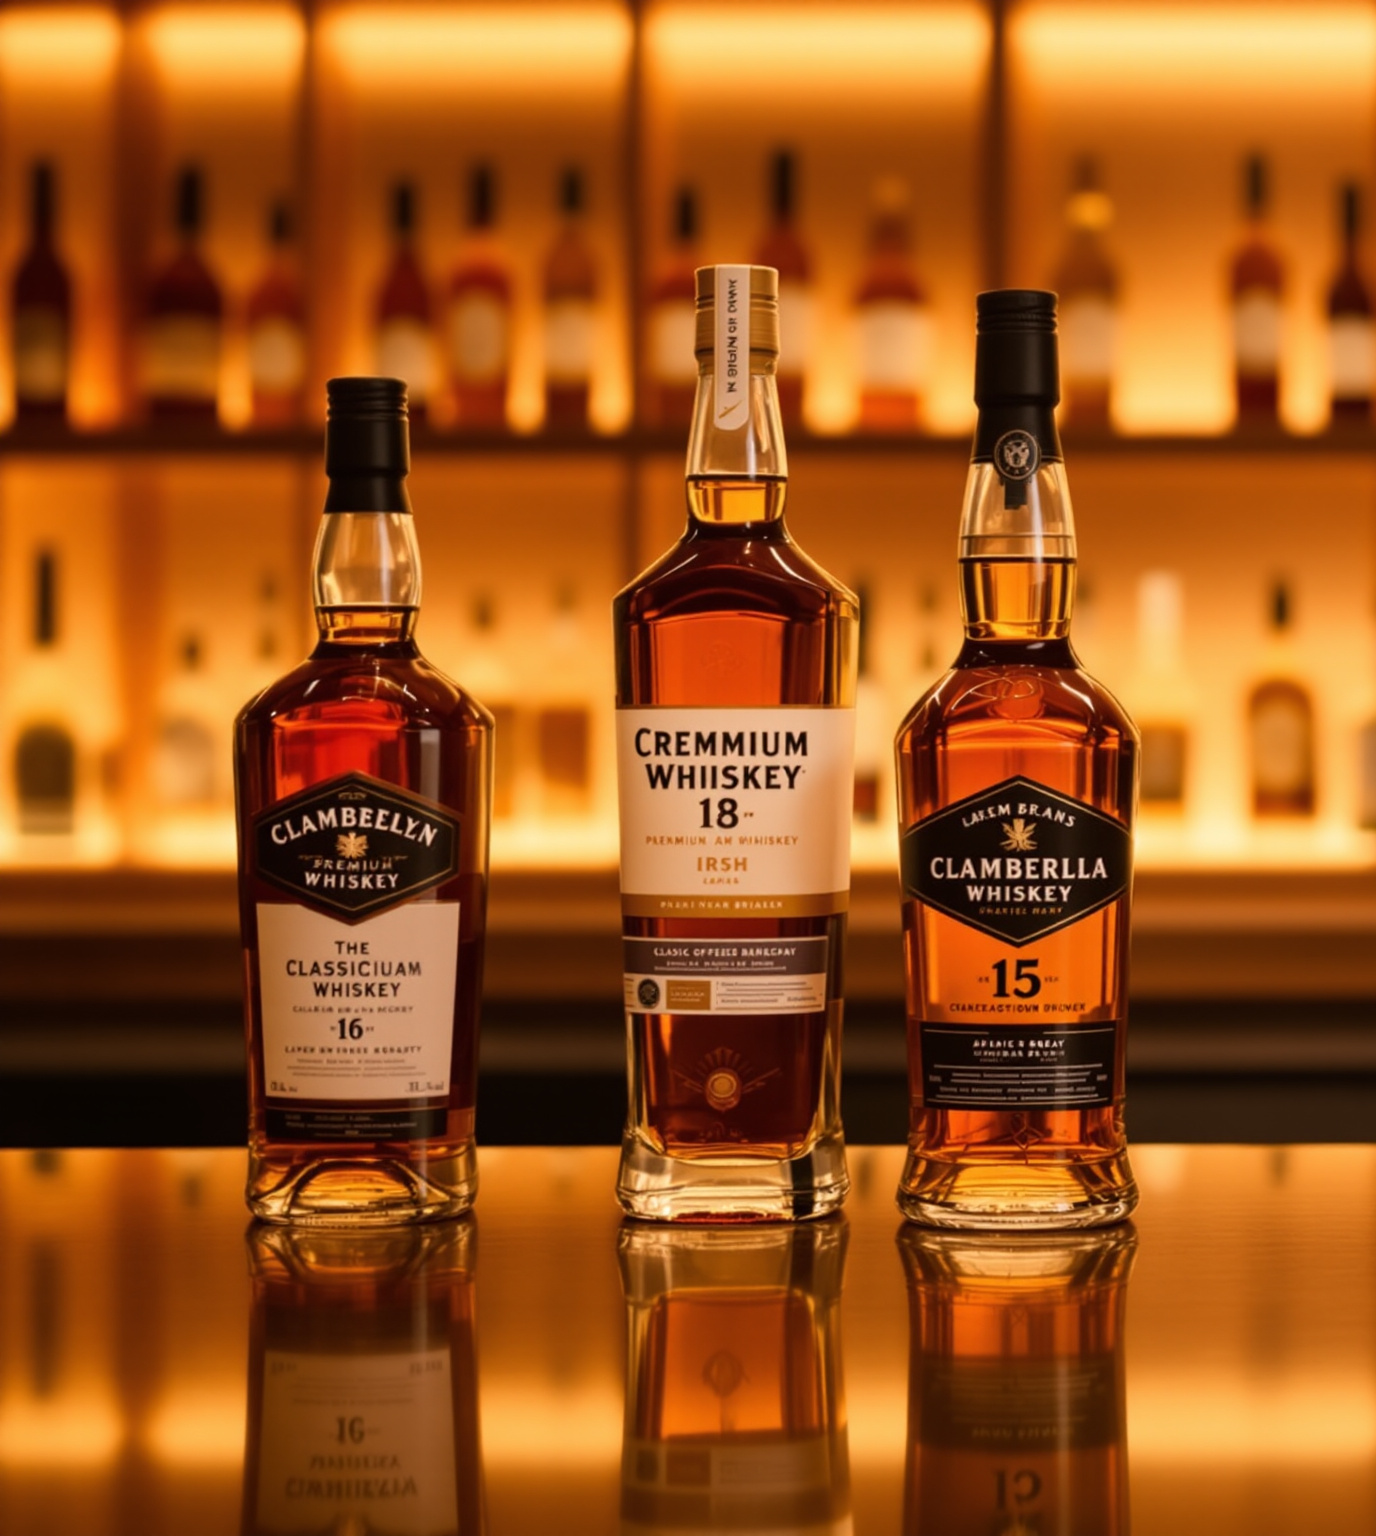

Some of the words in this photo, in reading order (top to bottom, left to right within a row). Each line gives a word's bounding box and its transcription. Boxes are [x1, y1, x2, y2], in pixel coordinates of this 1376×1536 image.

[635, 727, 808, 757] CREMMIUM
[699, 797, 739, 829] 18
[271, 806, 438, 847] CLAMBEELYN
[697, 856, 748, 872] IRSH
[930, 856, 1109, 880] CLAMBERLLA
[304, 871, 399, 889] WHISKEY
[966, 885, 1072, 902] WHISKEY
[334, 940, 370, 955] THE
[313, 982, 401, 998] WHISKEY
[992, 958, 1041, 999] 15
[338, 1017, 364, 1040] 16
